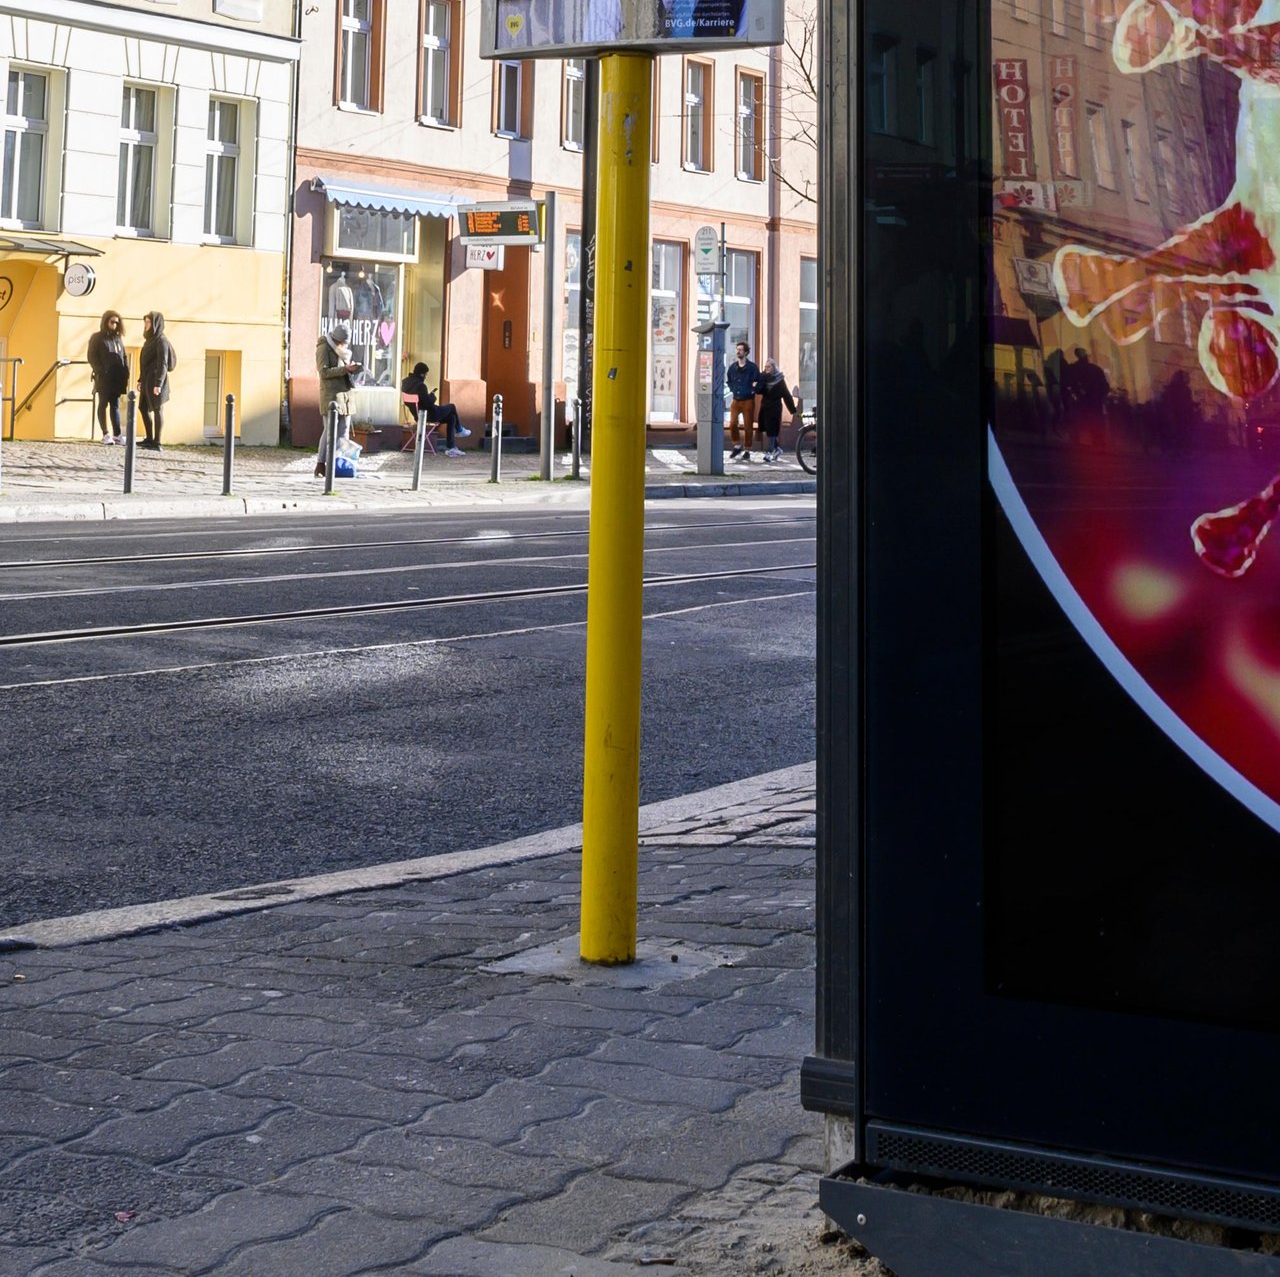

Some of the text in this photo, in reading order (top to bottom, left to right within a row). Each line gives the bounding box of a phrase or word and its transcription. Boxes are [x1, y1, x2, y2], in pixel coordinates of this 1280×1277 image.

[665, 18, 735, 28] BVG.de/Karriere
[470, 250, 486, 261] HERZ
[68, 274, 84, 285] pist
[352, 319, 379, 346] HERZ
[703, 337, 712, 349] P
